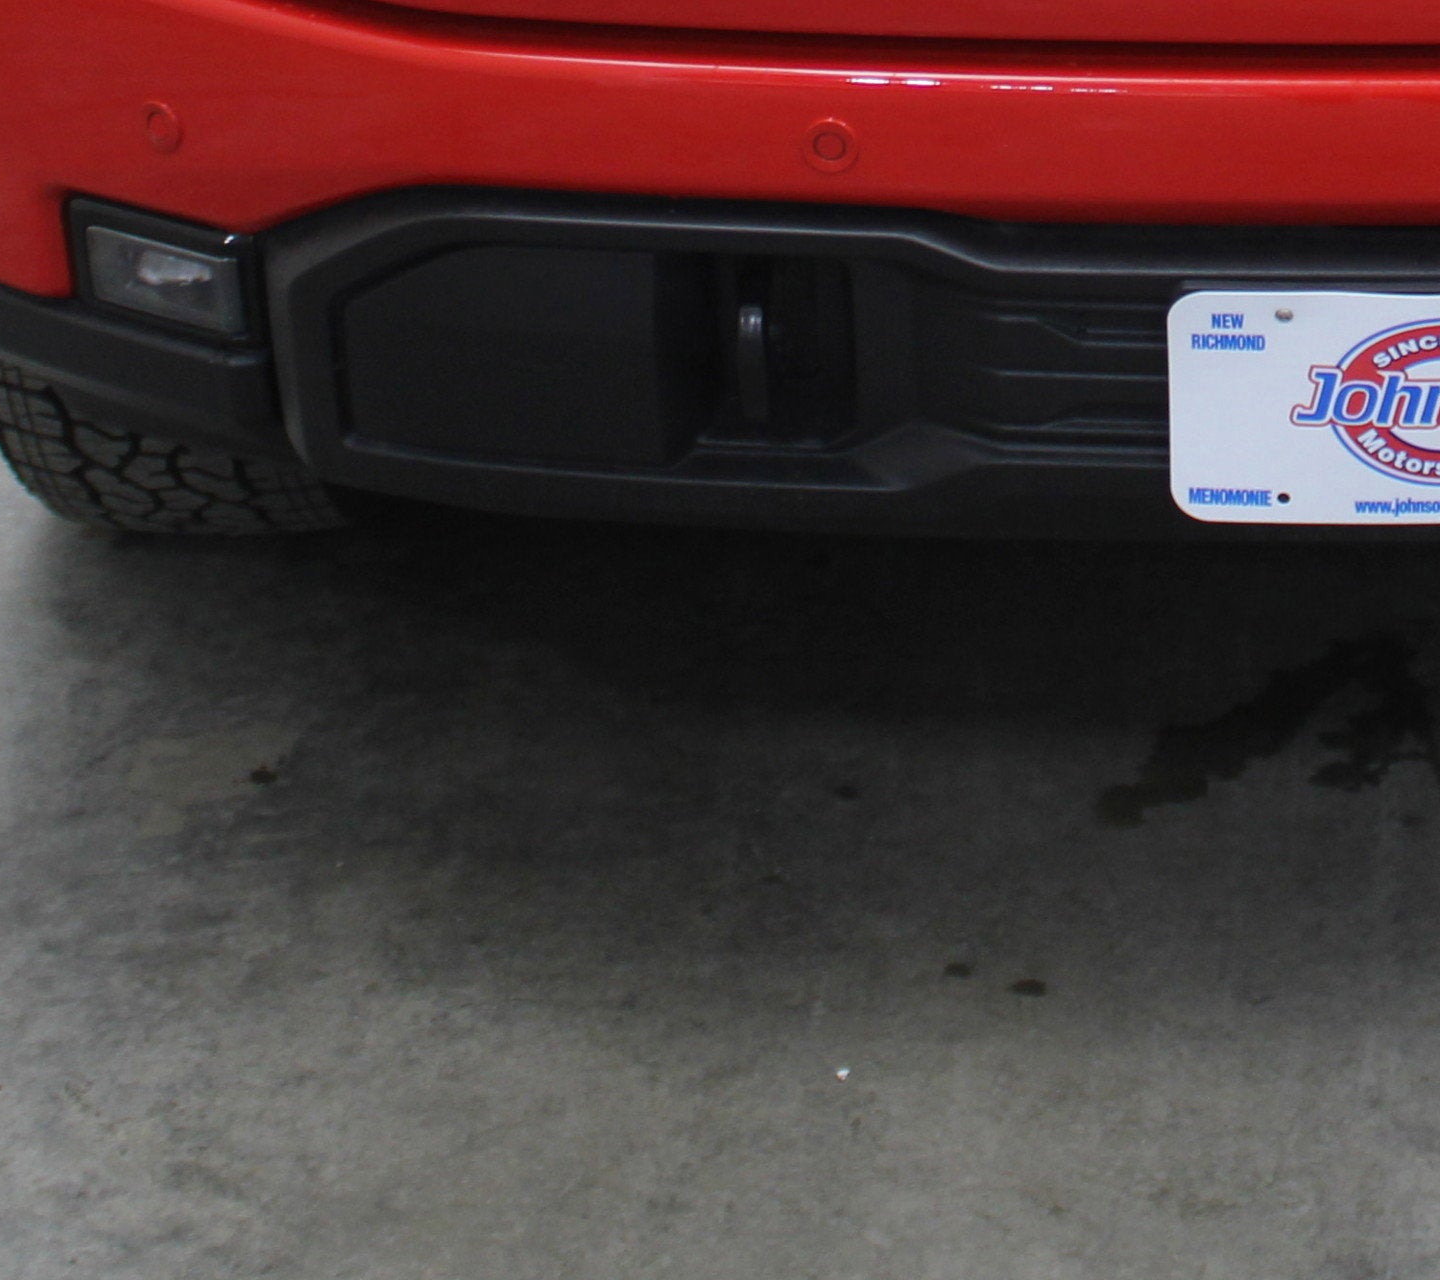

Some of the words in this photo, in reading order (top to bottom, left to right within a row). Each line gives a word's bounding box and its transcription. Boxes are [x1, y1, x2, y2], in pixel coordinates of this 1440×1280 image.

[1210, 313, 1244, 330] NEW
[1190, 333, 1266, 352] RICHMOND
[1187, 487, 1272, 507] MENOMONIE
